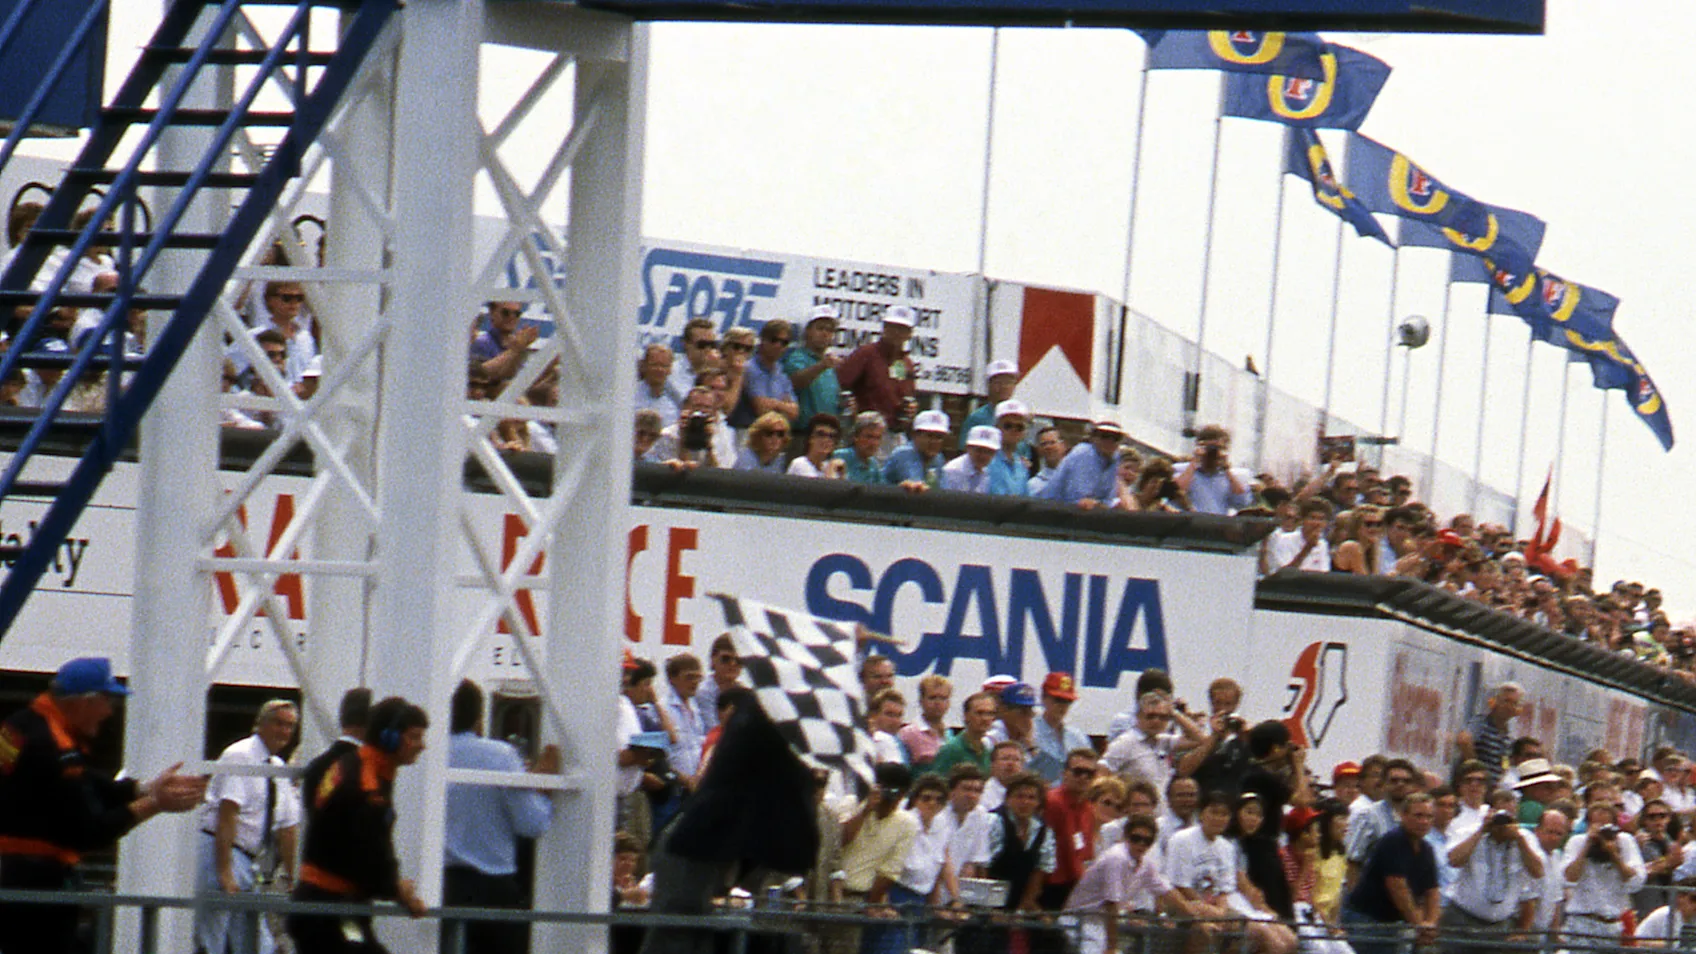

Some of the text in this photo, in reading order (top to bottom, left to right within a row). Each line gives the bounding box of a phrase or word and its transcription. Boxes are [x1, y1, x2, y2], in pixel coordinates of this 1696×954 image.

[814, 265, 925, 299] LEADERS IN
[805, 552, 1171, 689] SCANIA
